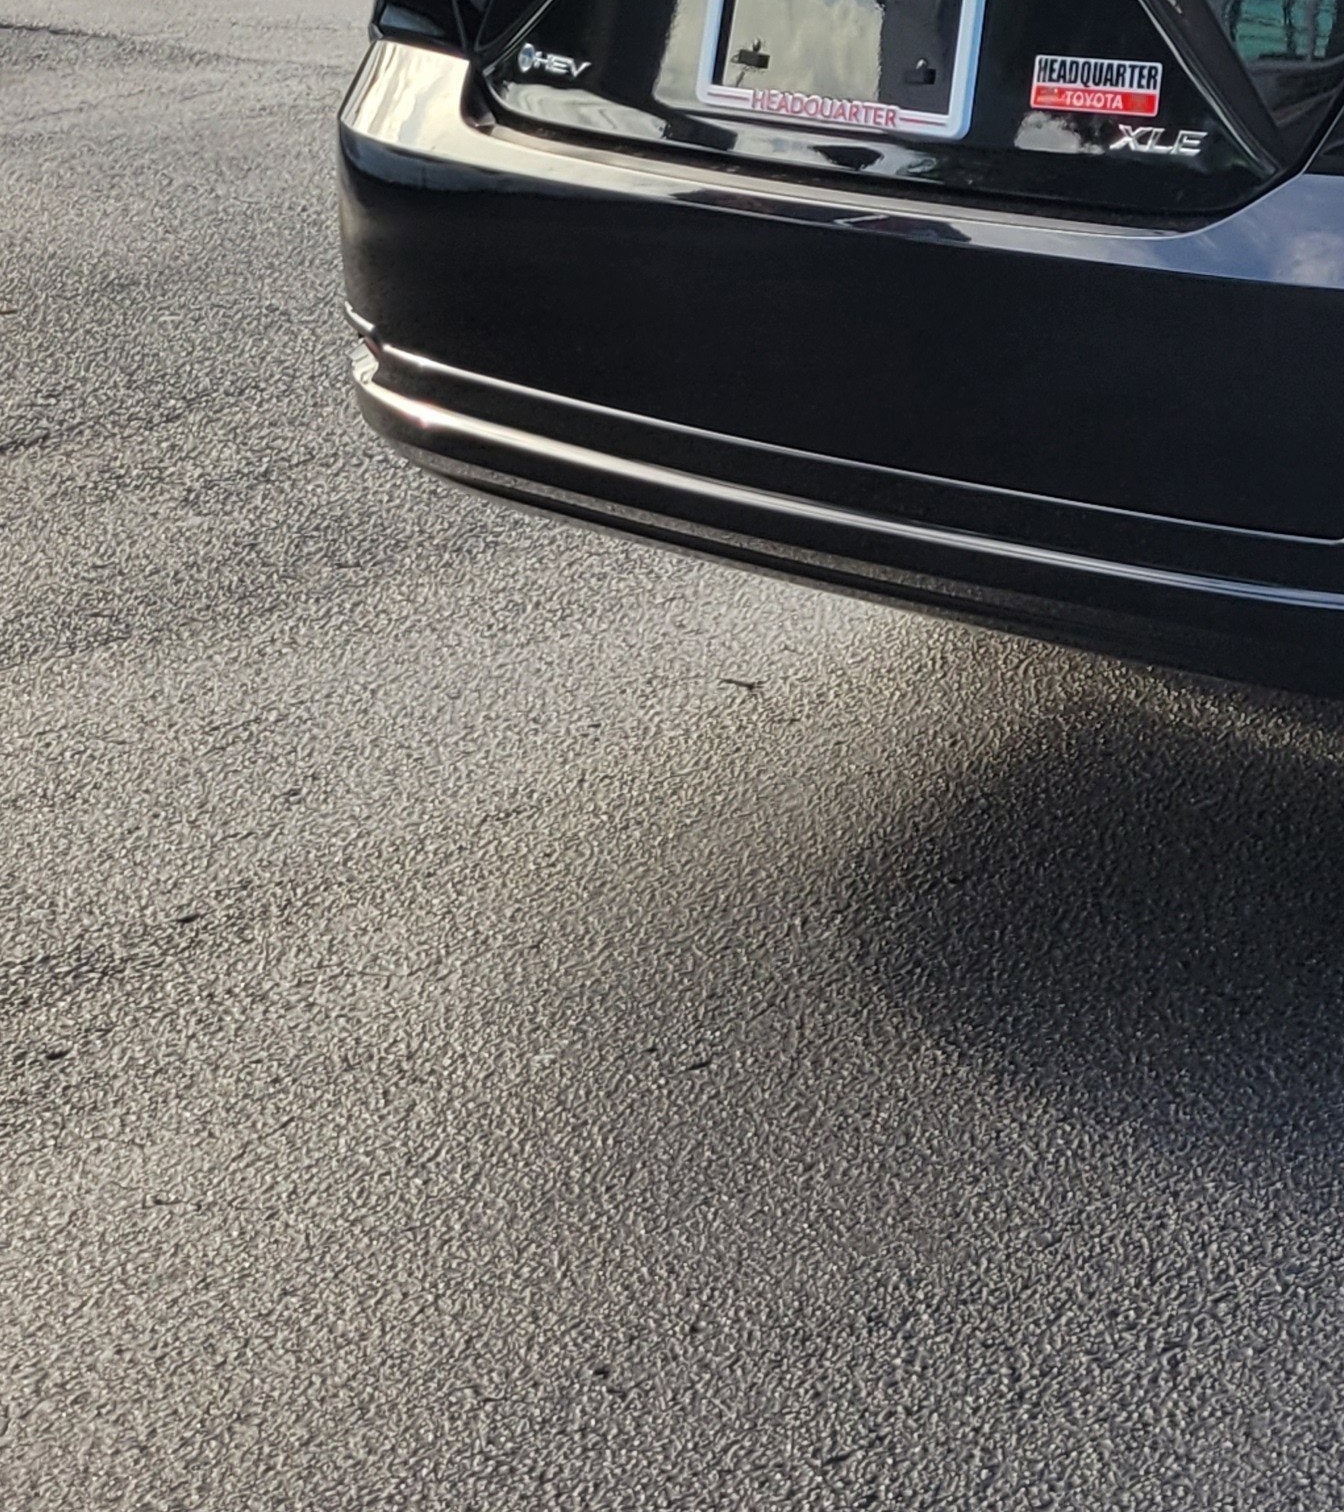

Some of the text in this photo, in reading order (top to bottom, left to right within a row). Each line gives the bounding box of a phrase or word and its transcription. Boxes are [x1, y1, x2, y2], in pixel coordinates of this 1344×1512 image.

[534, 51, 592, 78] HEV
[1037, 57, 1159, 91] HEADQUARTER
[1065, 90, 1124, 110] TOYOTA
[1109, 123, 1208, 157] XLE
